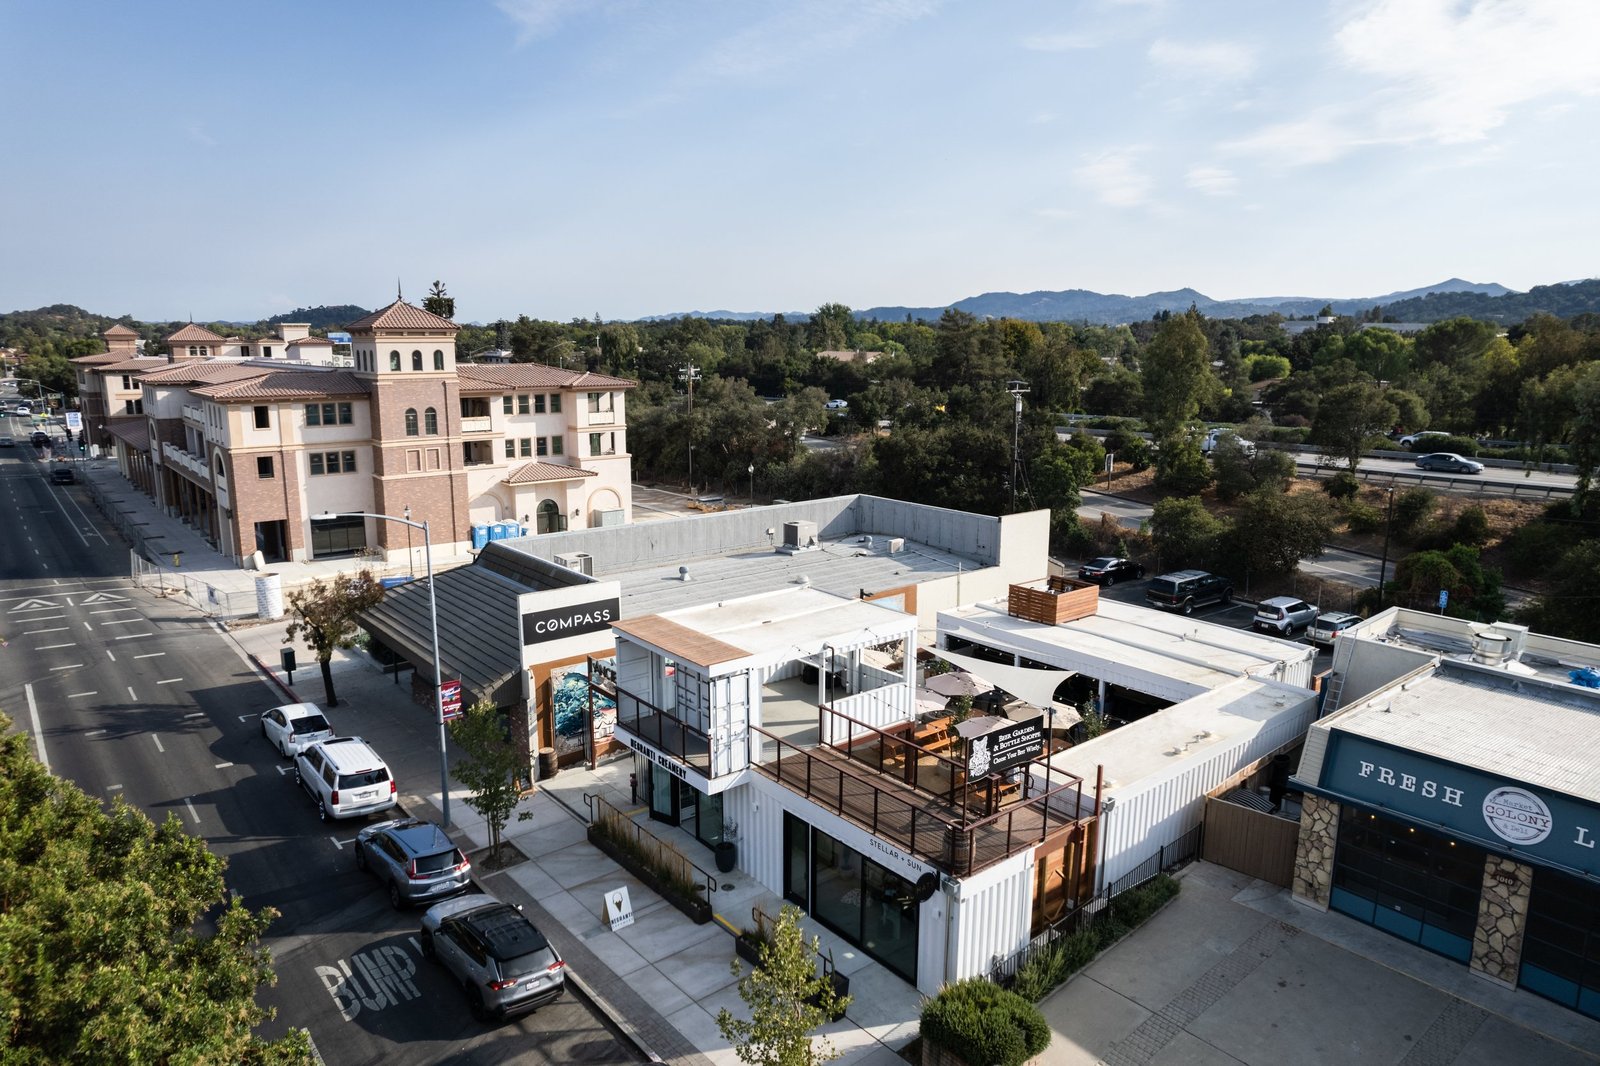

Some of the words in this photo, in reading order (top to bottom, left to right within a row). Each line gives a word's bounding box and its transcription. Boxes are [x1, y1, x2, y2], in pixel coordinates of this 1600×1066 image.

[535, 609, 611, 634] COMPASS
[1012, 726, 1035, 737] GARDEN
[993, 744, 999, 752] &
[999, 738, 1021, 750] BOTTLE
[1006, 752, 1017, 760] Your
[657, 755, 687, 780] CREAMERY
[1358, 760, 1465, 807] FRESH
[1485, 804, 1551, 829] COLONY
[1503, 799, 1533, 811] Market
[1510, 825, 1529, 835] Deli
[1573, 826, 1596, 849] L
[869, 838, 899, 860] STELLAR
[906, 858, 922, 872] SUN
[314, 945, 422, 1022] BUMP
